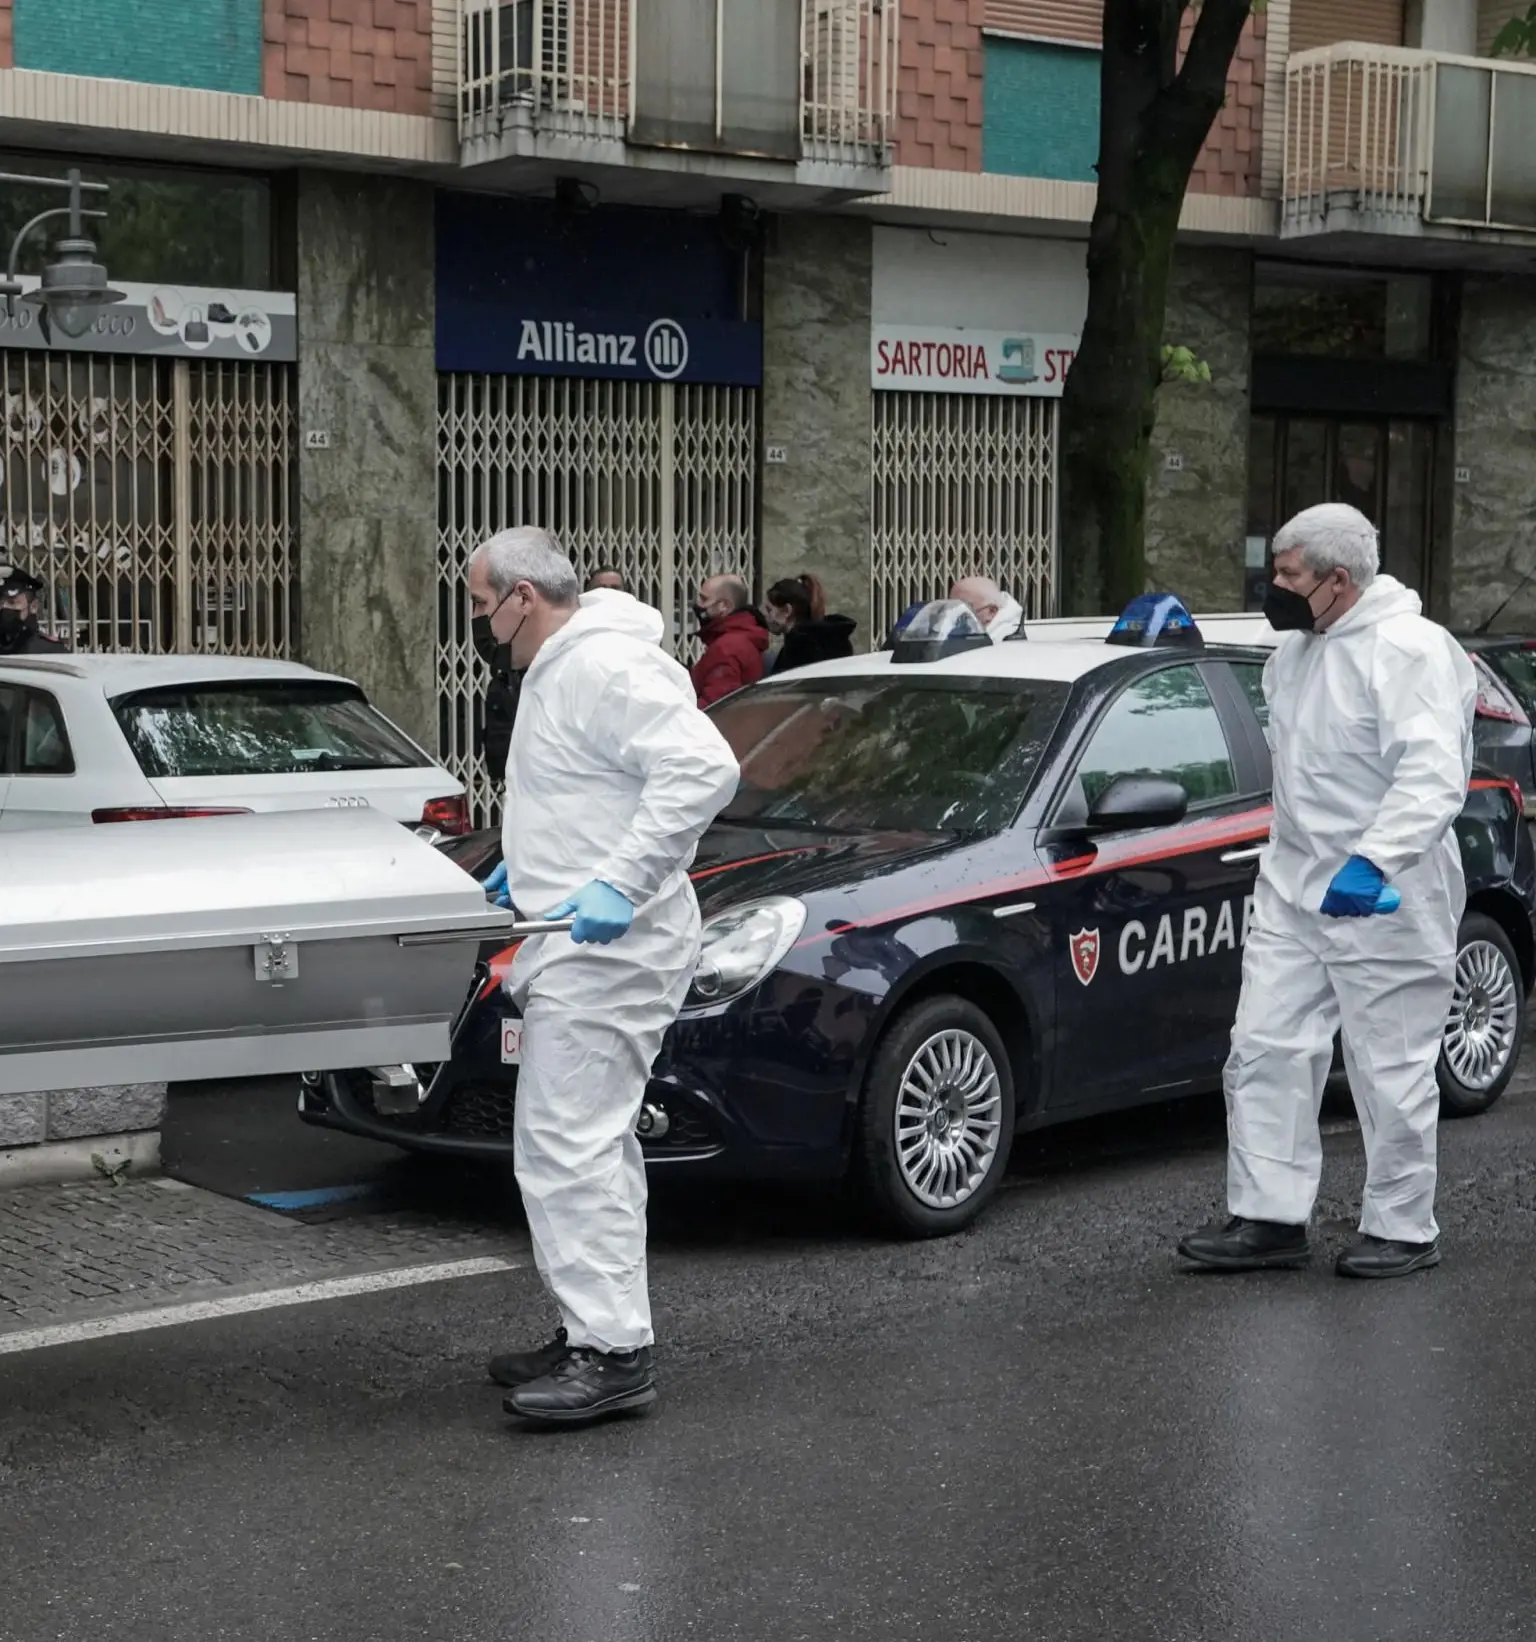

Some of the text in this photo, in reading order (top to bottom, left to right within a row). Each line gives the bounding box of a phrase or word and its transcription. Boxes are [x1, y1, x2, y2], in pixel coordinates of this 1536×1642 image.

[517, 320, 637, 366] Allianz
[876, 340, 990, 380] SARTORIA
[504, 1029, 523, 1054] C
